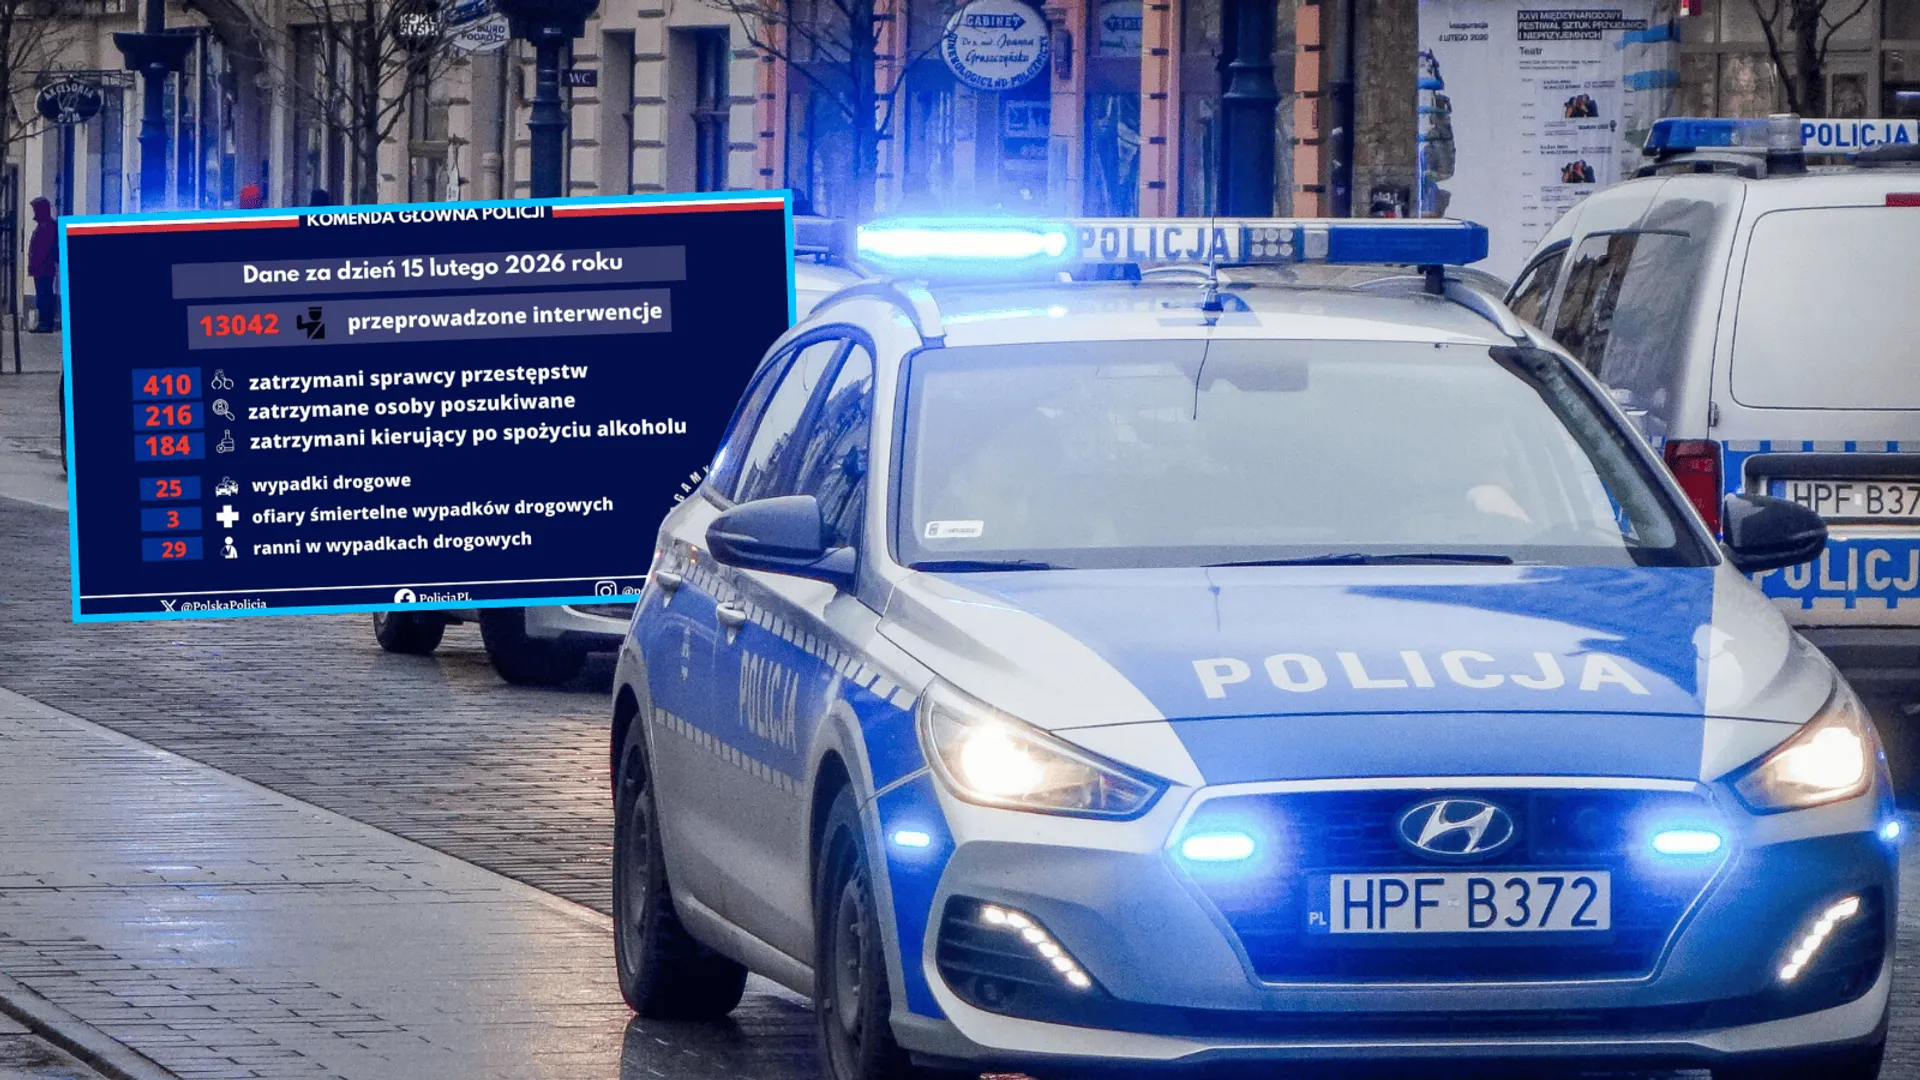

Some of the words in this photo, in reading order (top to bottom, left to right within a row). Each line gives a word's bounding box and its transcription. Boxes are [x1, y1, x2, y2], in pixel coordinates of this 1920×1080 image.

[967, 15, 1020, 27] GABINET
[1519, 21, 1560, 30] FESTIWAL
[1562, 20, 1591, 30] SZTUK
[1523, 31, 1601, 39] NIEPRZYJEMNYCH
[1519, 46, 1543, 56] Teatr
[569, 72, 591, 84] WC
[43, 82, 95, 101] AKCESORIA
[1802, 122, 1911, 148] POLICJA
[1081, 227, 1232, 262] POLICJA
[1794, 483, 1853, 514] HPF
[1867, 484, 1920, 515] B37
[1192, 650, 1651, 699] POLICJA
[739, 650, 799, 754] POLICJA
[1309, 911, 1327, 926] PL
[1343, 878, 1445, 930] HPF
[1467, 877, 1598, 929] B372
